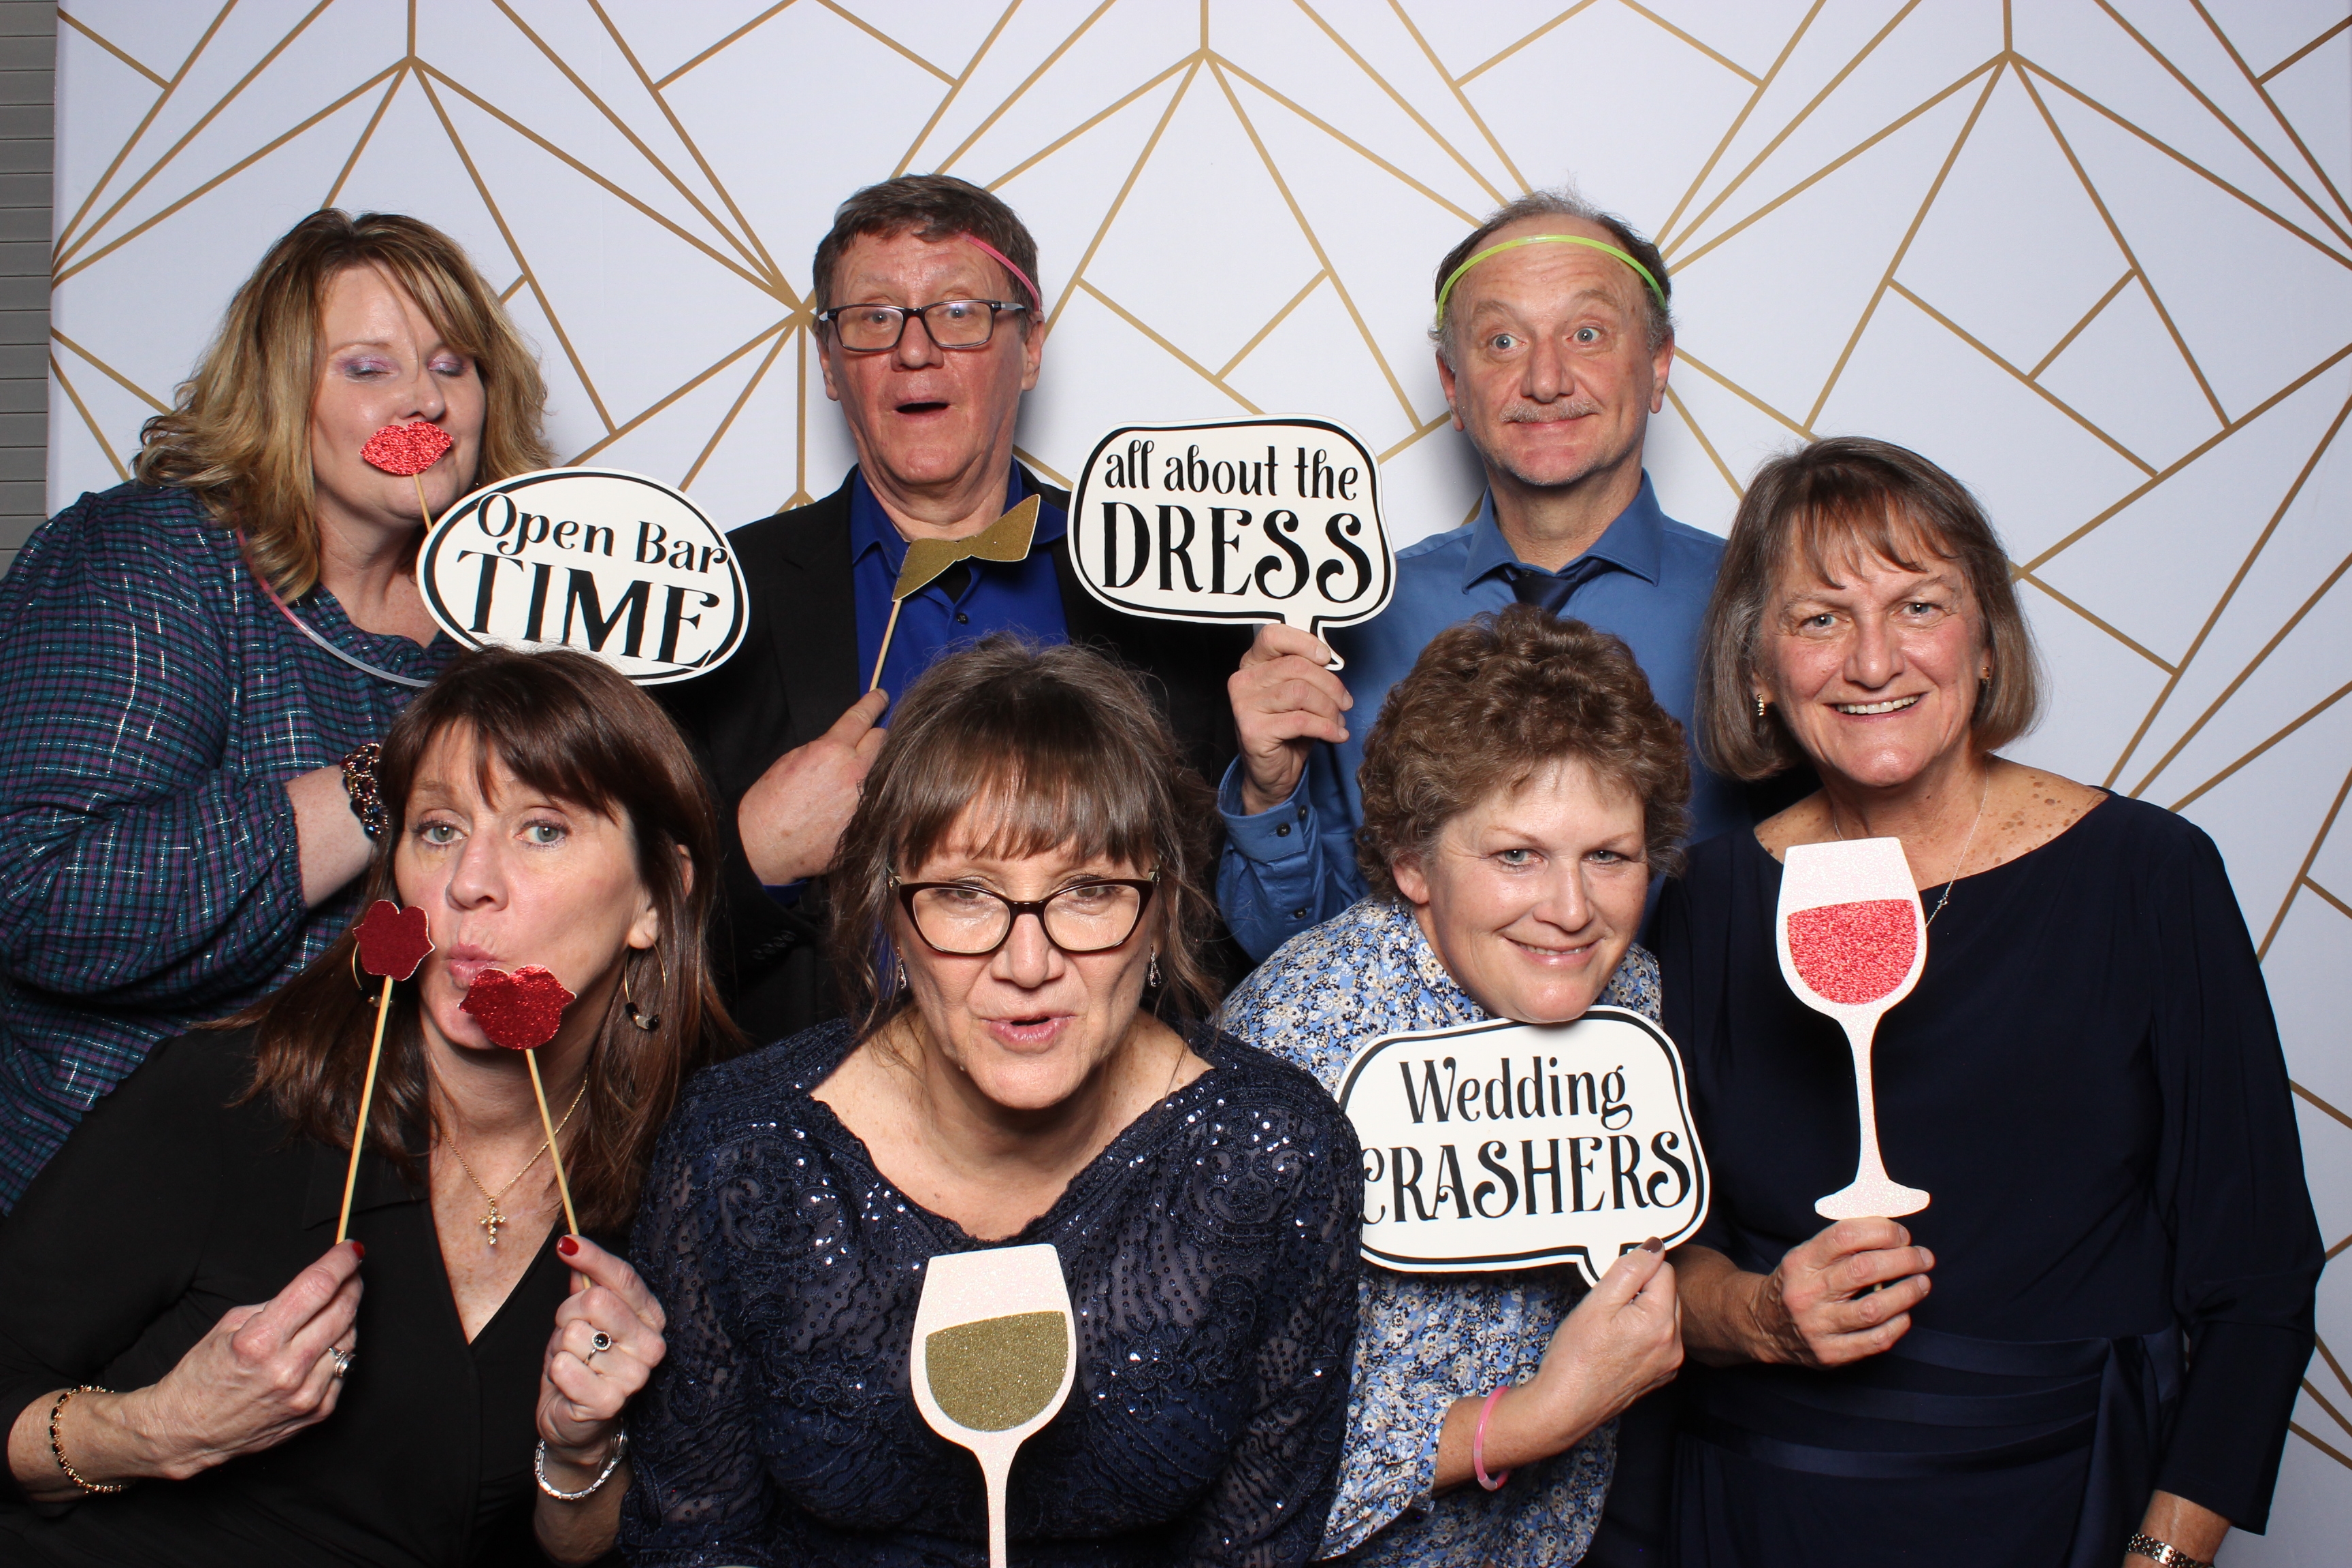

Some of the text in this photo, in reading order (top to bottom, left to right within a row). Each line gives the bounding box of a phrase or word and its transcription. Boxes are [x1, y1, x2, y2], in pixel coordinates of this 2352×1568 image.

[1105, 440, 1358, 500] all about the
[477, 493, 729, 574] Open Bar
[1100, 502, 1373, 604] DRESS
[456, 550, 720, 668] TIME
[1399, 1056, 1633, 1131] Wedding
[1362, 1130, 1691, 1226] CRASHERS
